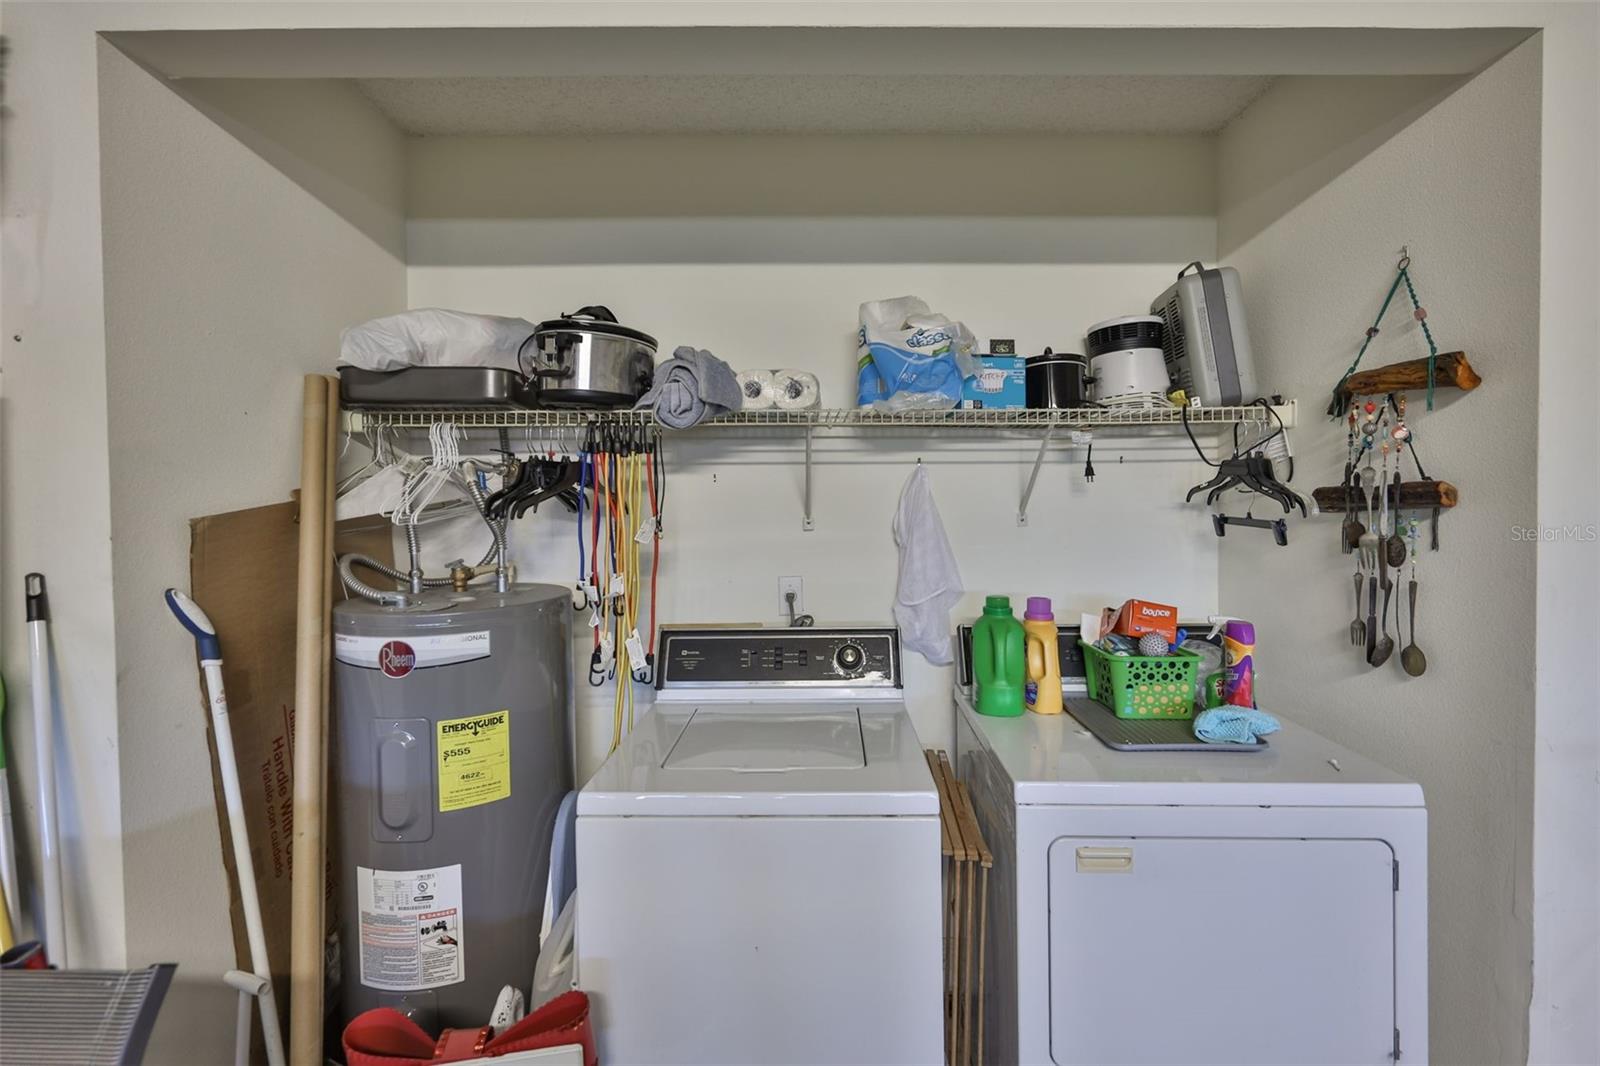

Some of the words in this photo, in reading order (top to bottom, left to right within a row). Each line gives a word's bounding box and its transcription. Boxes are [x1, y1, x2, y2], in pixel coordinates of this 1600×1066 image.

[1142, 607, 1171, 617] bounce
[382, 641, 414, 672] Rheem
[442, 715, 504, 736] ENERGYGUIDE
[443, 747, 471, 758] $555
[272, 736, 288, 797] Handle
[267, 805, 276, 829] con
[271, 830, 283, 878] cuidado
